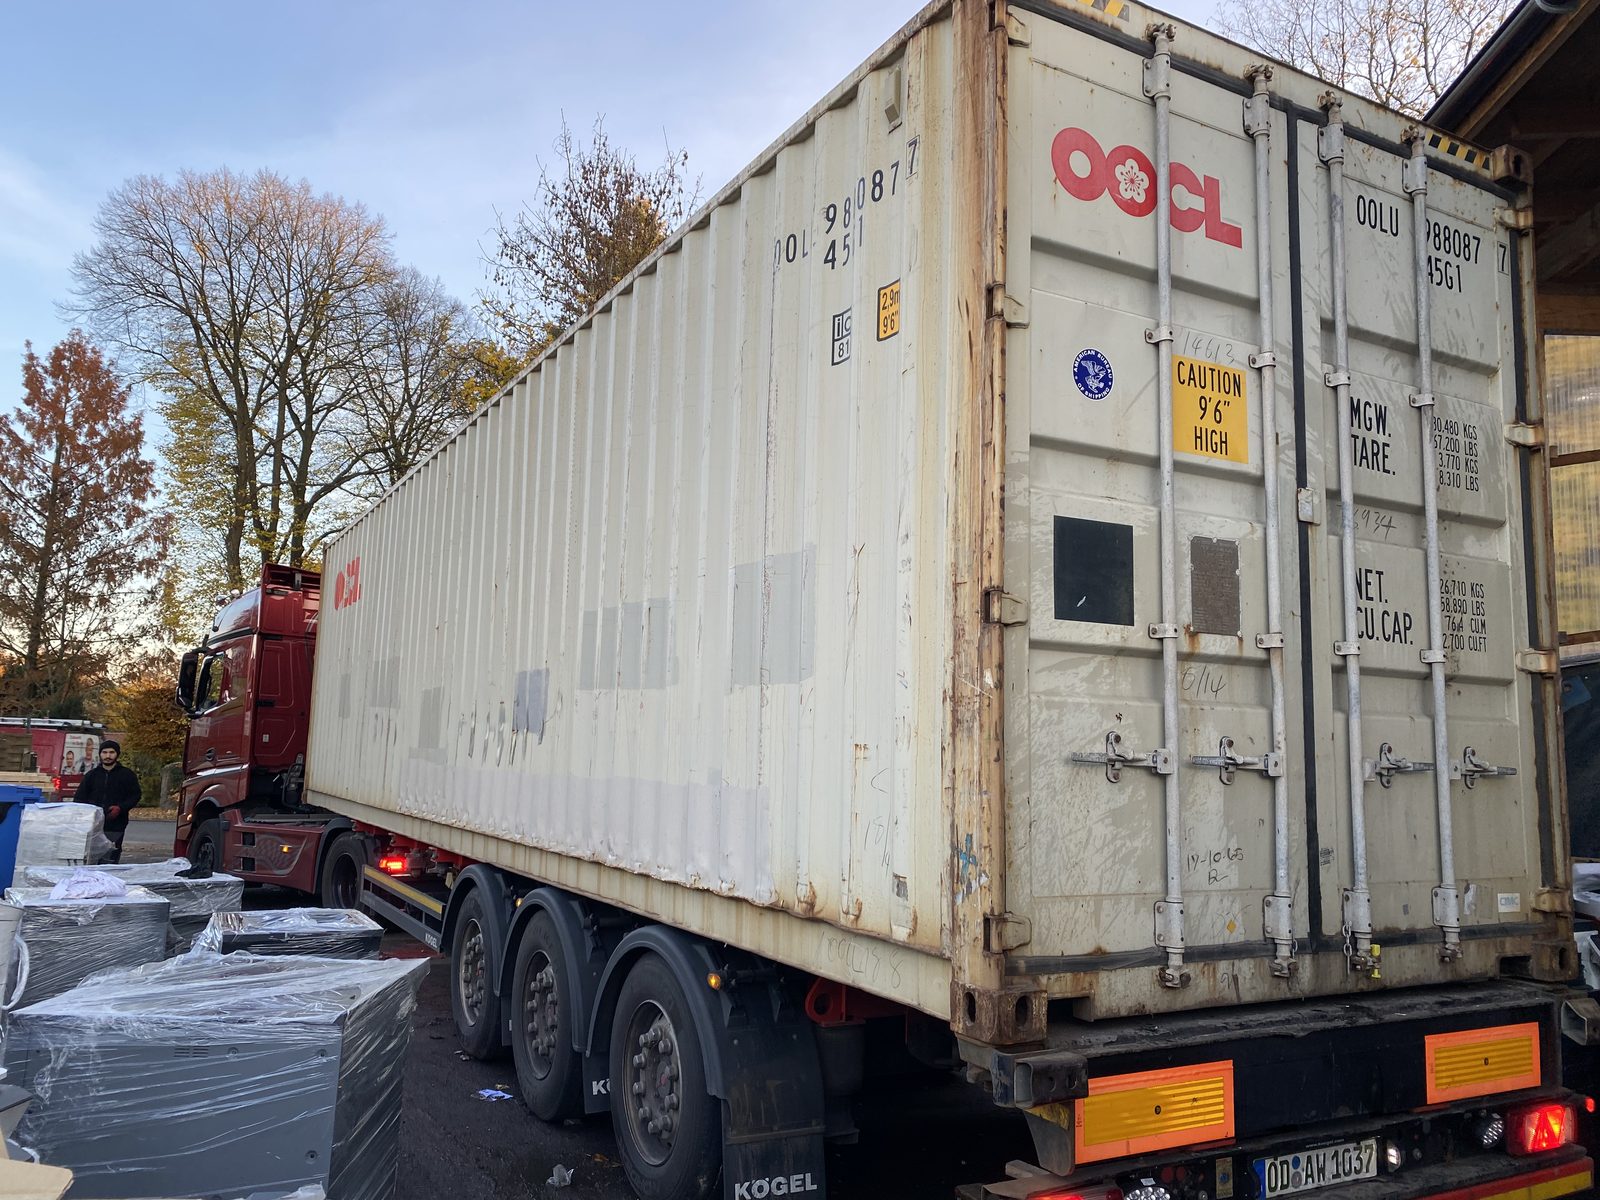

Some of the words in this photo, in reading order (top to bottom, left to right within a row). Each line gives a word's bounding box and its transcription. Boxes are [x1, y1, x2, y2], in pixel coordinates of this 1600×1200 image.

[1051, 126, 1243, 249] OOCL
[1356, 194, 1399, 237] OOLU
[1073, 350, 1096, 373] AMERICAN
[1096, 352, 1113, 379] BUREAU
[1177, 360, 1242, 398] CAUTION
[1198, 395, 1231, 424] 9'6"
[1350, 396, 1392, 438] MGW.
[1194, 425, 1229, 456] HIGH
[1463, 423, 1478, 441] KGS
[1351, 434, 1396, 476] TARE.
[1439, 452, 1461, 471] 3.770
[1465, 457, 1479, 475] KGS
[1464, 441, 1479, 458] LBS
[1439, 470, 1461, 489] 8.310
[1465, 475, 1480, 492] LBS
[1471, 582, 1485, 599] KGS
[1472, 600, 1486, 617] LBS
[1303, 1152, 1327, 1186] AW
[1331, 1143, 1376, 1180] 1037
[734, 1172, 818, 1200] KÖGEL
